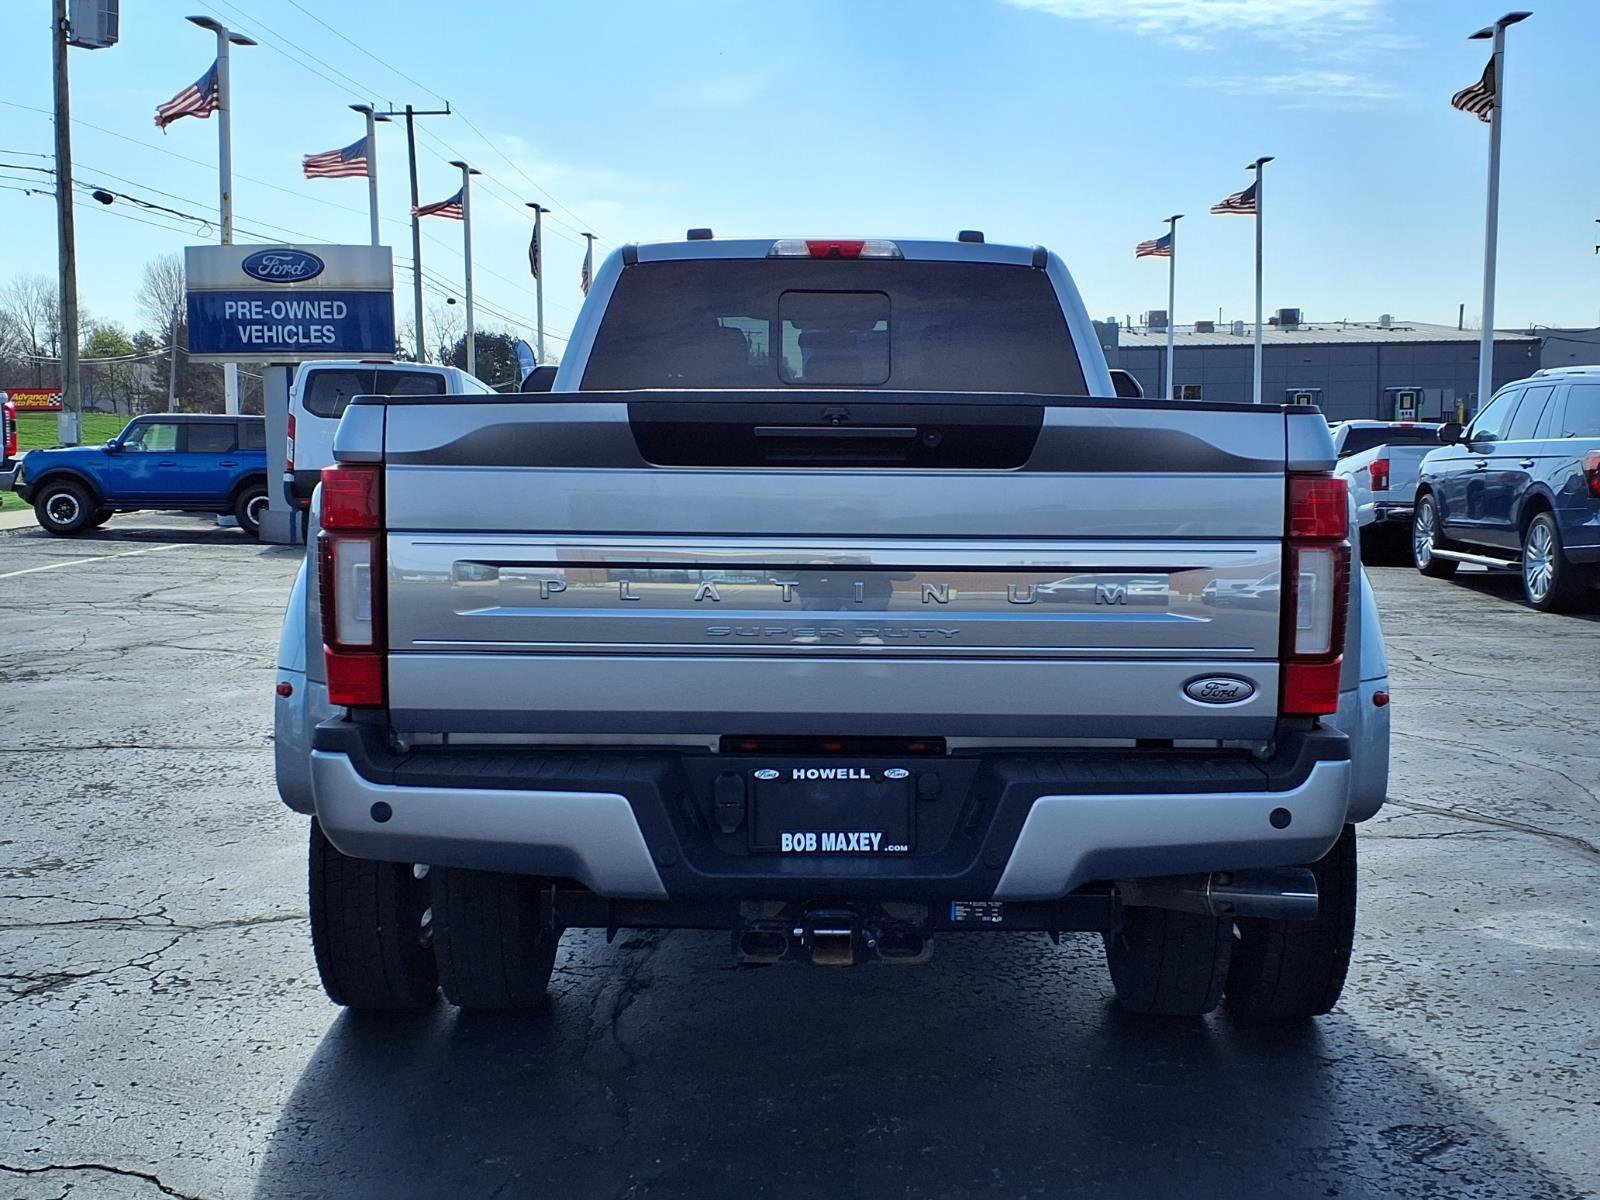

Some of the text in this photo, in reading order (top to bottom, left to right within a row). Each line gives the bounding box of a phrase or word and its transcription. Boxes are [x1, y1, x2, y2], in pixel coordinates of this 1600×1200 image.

[257, 254, 306, 275] Ford
[225, 301, 348, 320] PRE-OWNED
[238, 325, 336, 344] VEHICLES
[539, 578, 1128, 606] PLATINUM
[706, 625, 961, 639] SUPER DUTY
[1200, 681, 1239, 698] Ford
[792, 768, 871, 780] HOWELL
[781, 833, 817, 852] BOB
[821, 832, 882, 852] MAXEY
